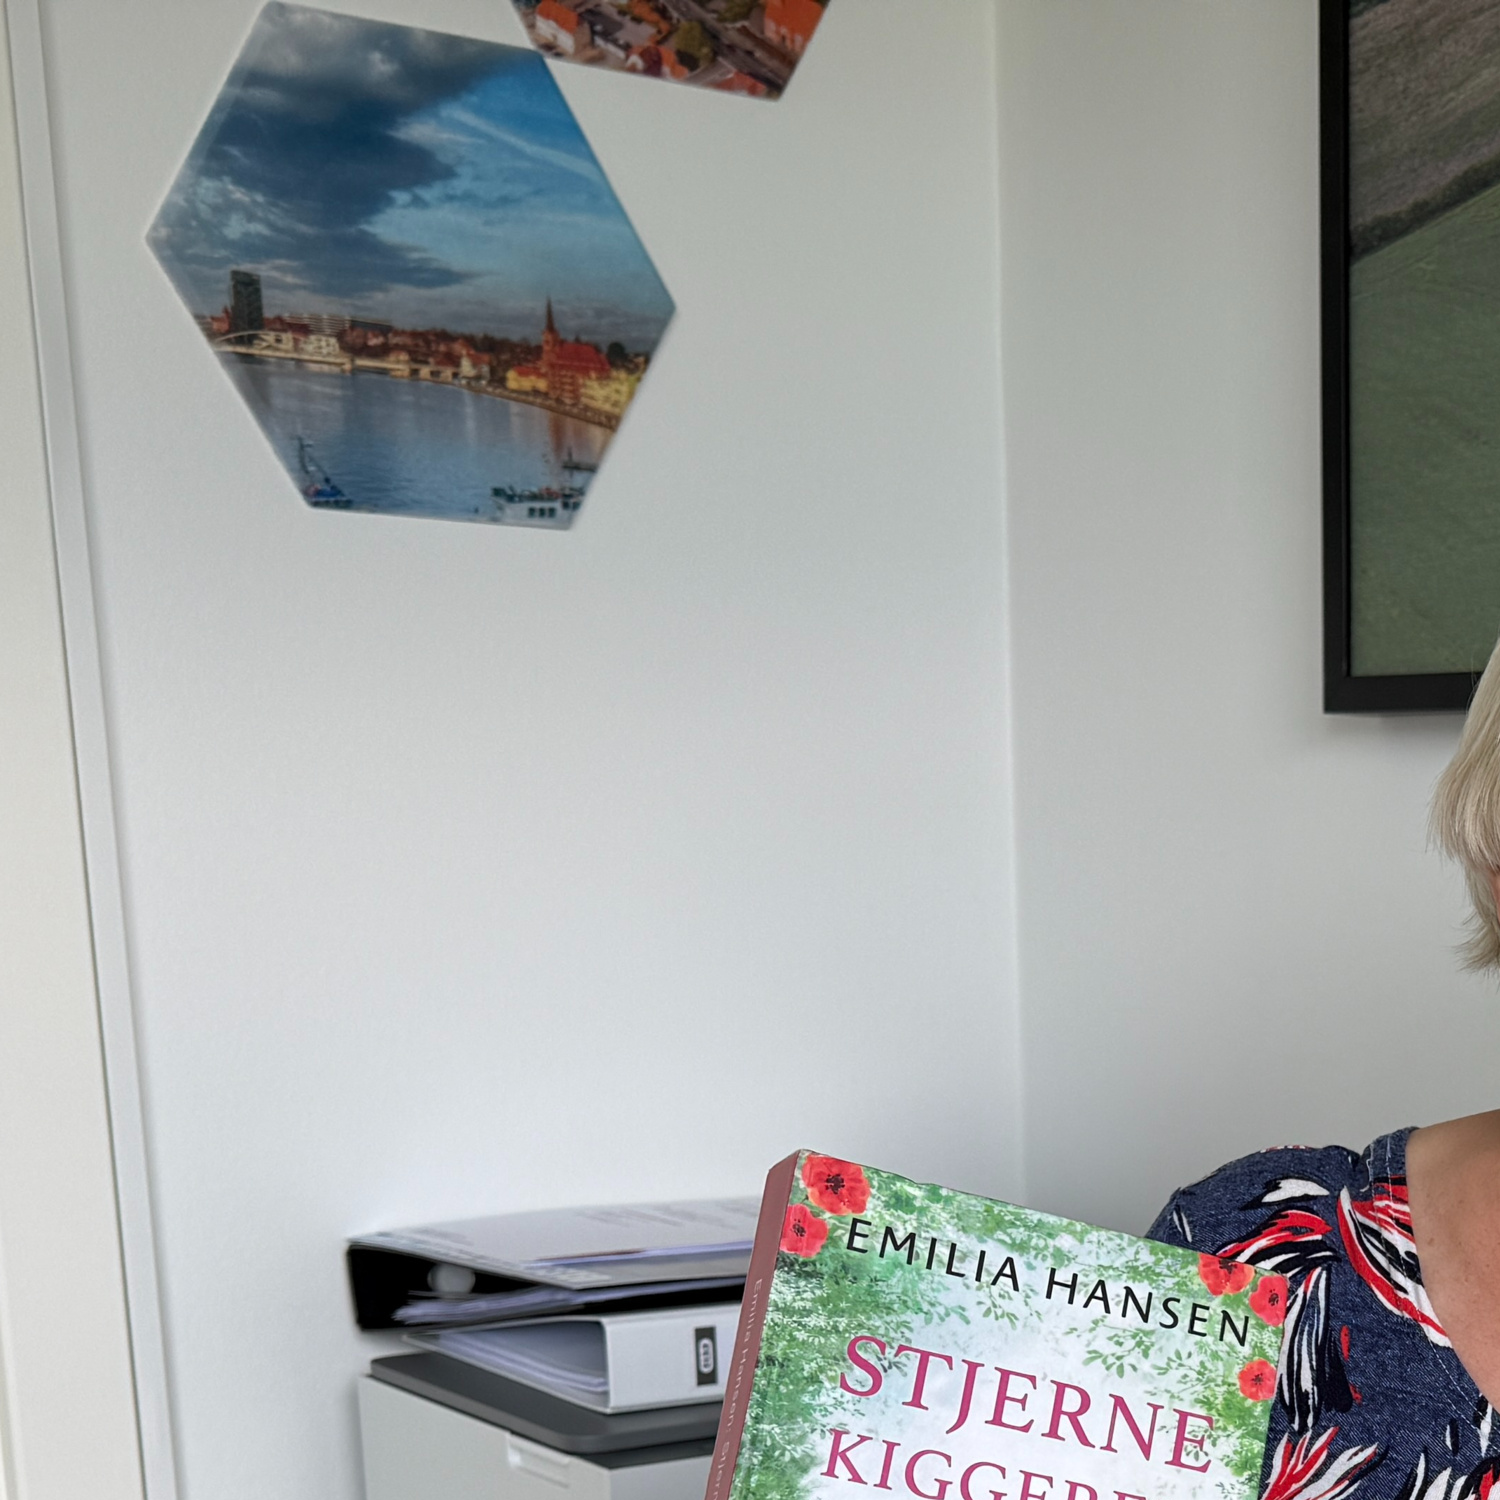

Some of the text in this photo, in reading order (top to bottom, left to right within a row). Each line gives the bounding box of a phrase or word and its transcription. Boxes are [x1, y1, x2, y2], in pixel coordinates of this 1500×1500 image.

[744, 1278, 763, 1343] Emilia
[846, 1217, 1250, 1347] EMILIA HANSEN
[839, 1335, 1214, 1474] STJERNE
